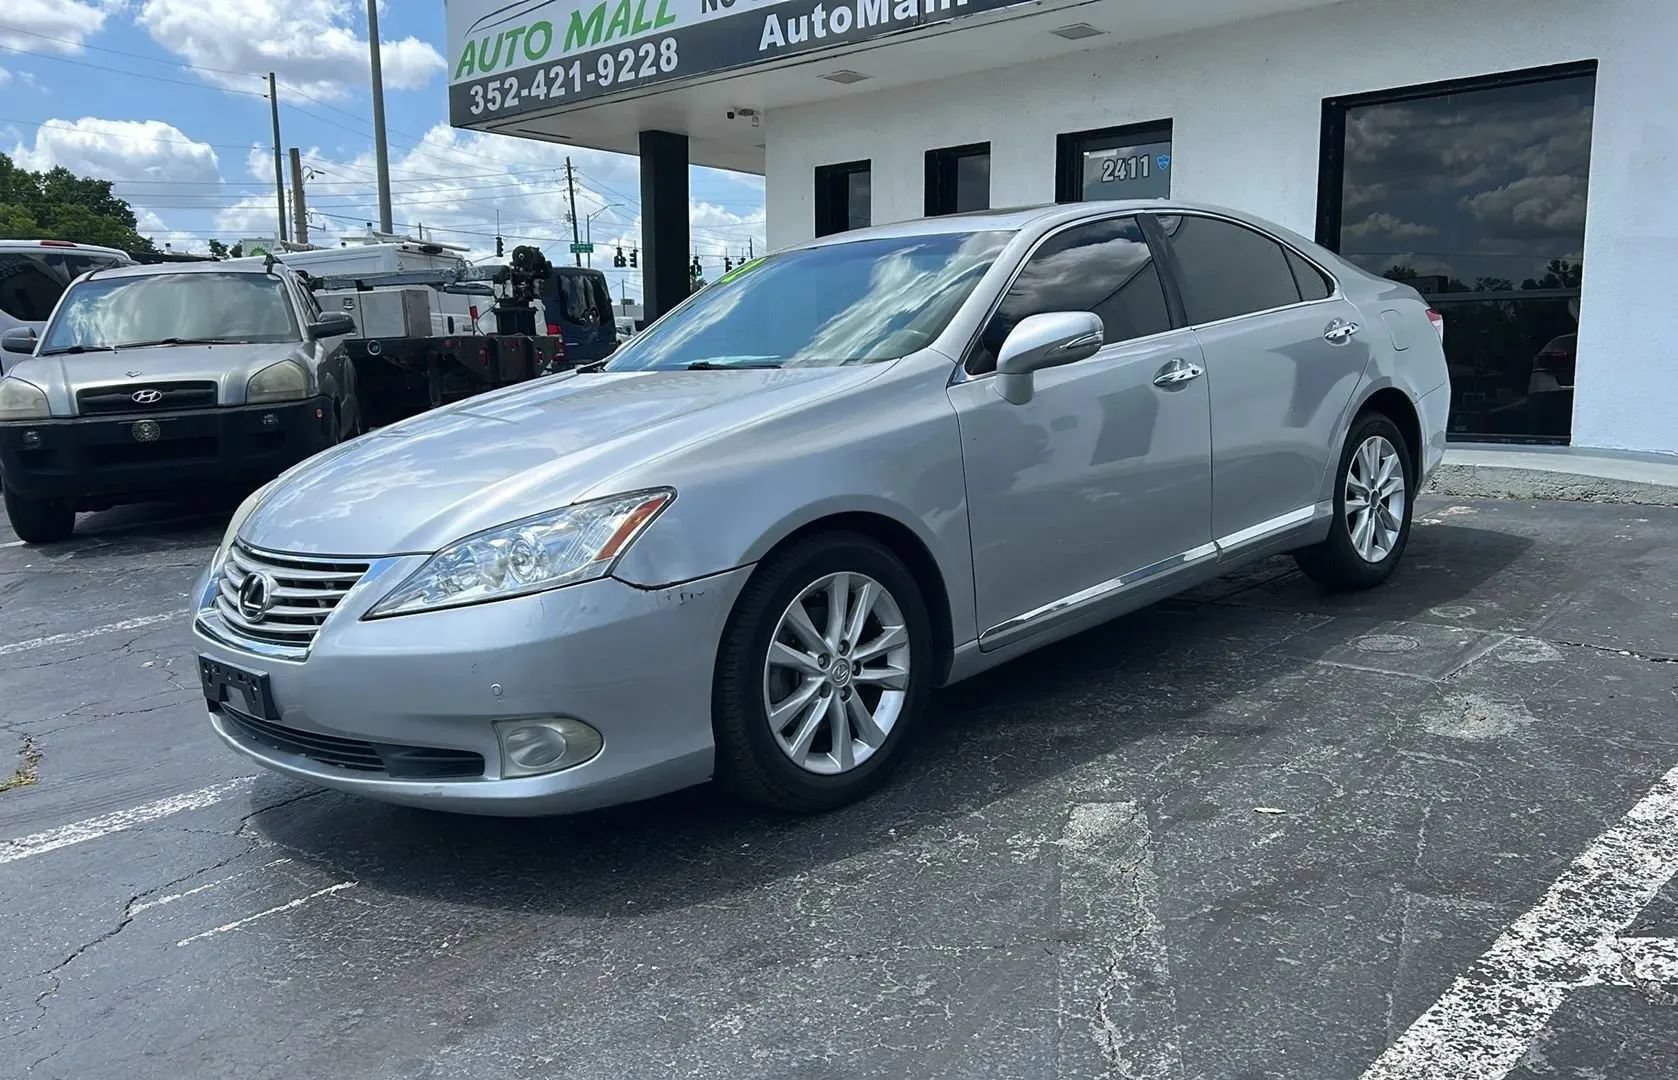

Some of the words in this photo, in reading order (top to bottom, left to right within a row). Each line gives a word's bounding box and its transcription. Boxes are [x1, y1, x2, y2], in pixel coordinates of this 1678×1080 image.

[454, 20, 553, 80] AUTO
[563, 0, 677, 53] MALL
[470, 37, 679, 115] 352-421-9228
[1101, 154, 1150, 183] 2411
